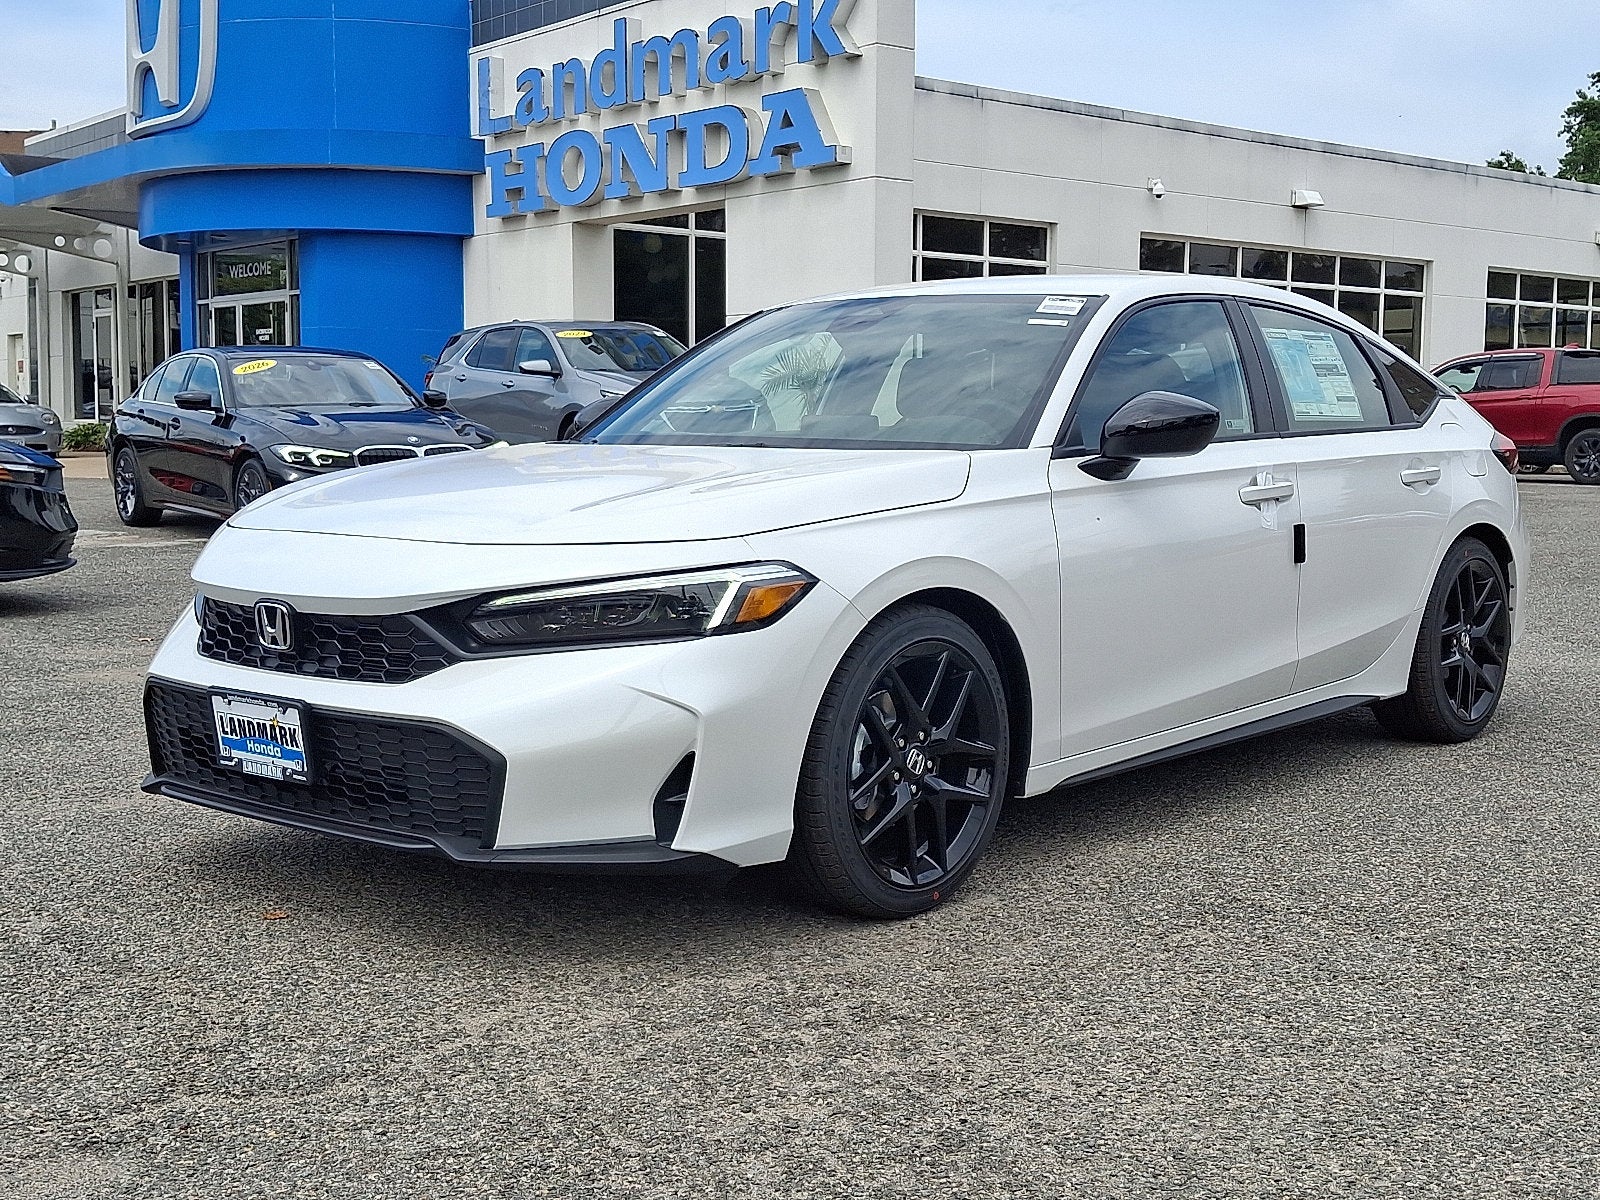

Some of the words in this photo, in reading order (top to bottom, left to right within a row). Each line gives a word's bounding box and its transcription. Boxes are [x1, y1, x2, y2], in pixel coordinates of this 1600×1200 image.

[477, 0, 848, 137] Landmark
[485, 87, 838, 219] HONDA
[229, 260, 272, 279] WELCOME
[240, 361, 270, 373] 2026
[218, 713, 300, 749] LANDMARK
[246, 739, 282, 758] Honda
